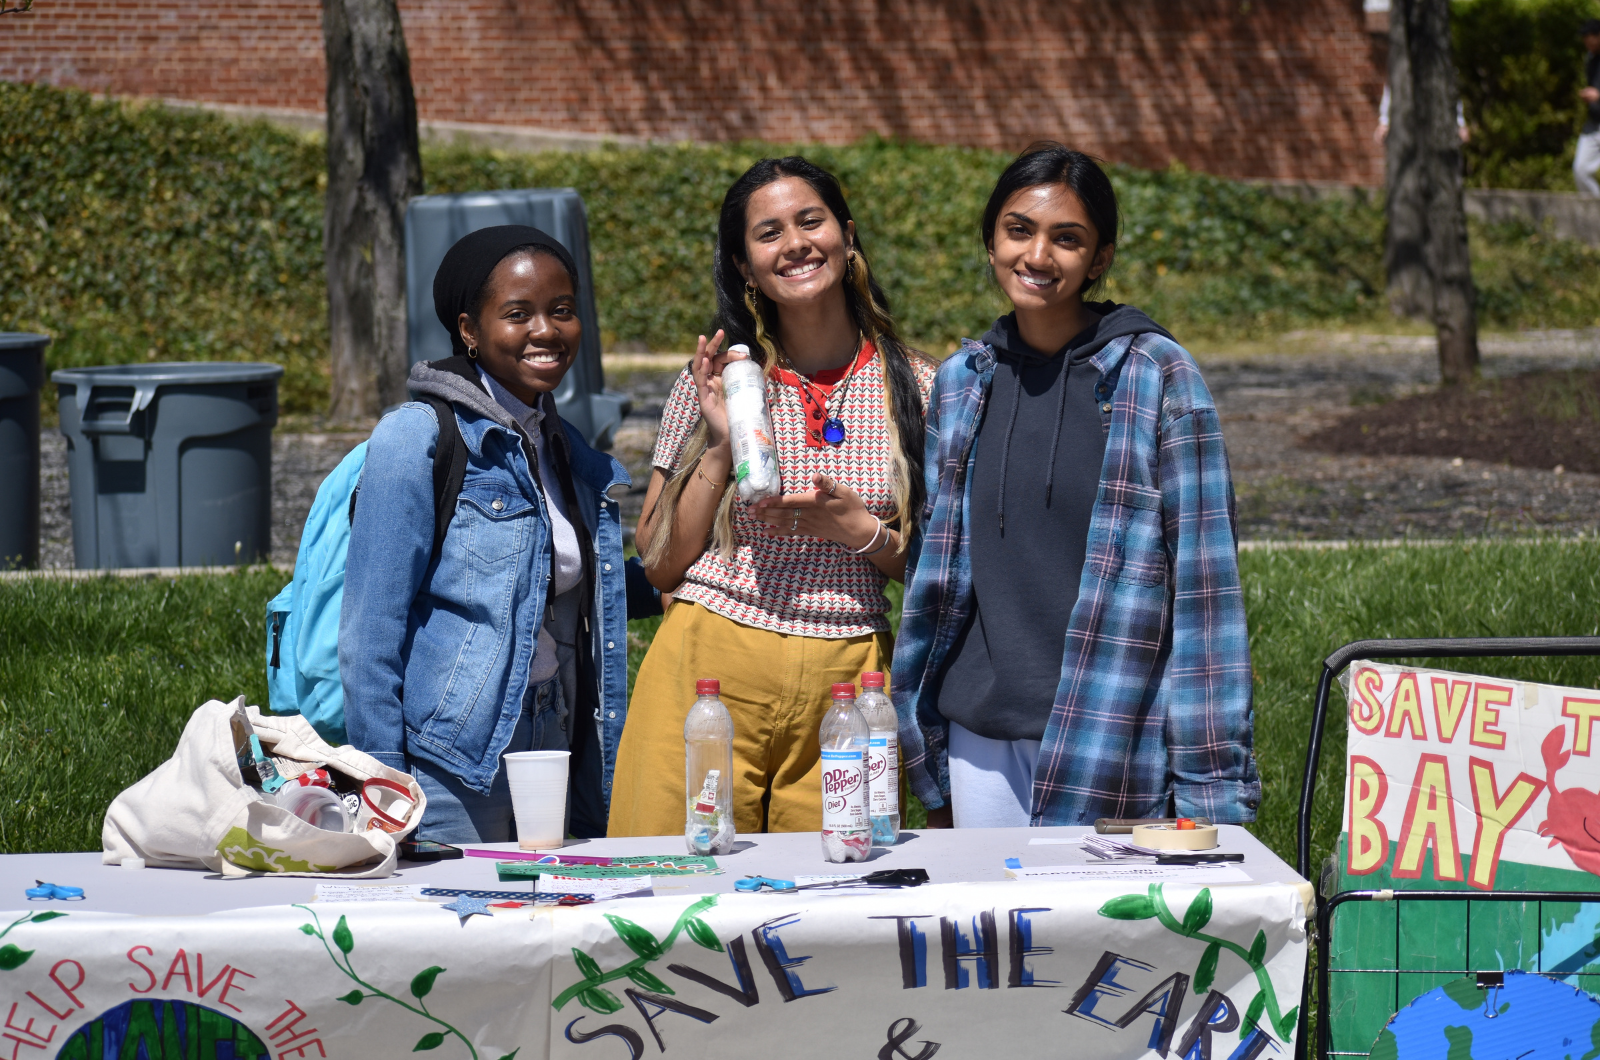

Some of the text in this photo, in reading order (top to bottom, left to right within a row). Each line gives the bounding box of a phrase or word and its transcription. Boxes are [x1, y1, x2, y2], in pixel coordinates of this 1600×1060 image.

[1350, 667, 1513, 751] SAVE
[824, 771, 860, 794] Pepper
[828, 800, 841, 810] Diet
[833, 769, 849, 782] Dr
[1346, 753, 1547, 891] BAY
[0, 959, 85, 1060] HELP
[126, 945, 256, 1012] SAVE
[264, 999, 327, 1060] THE
[564, 906, 1287, 1060] SAVE THE EART
